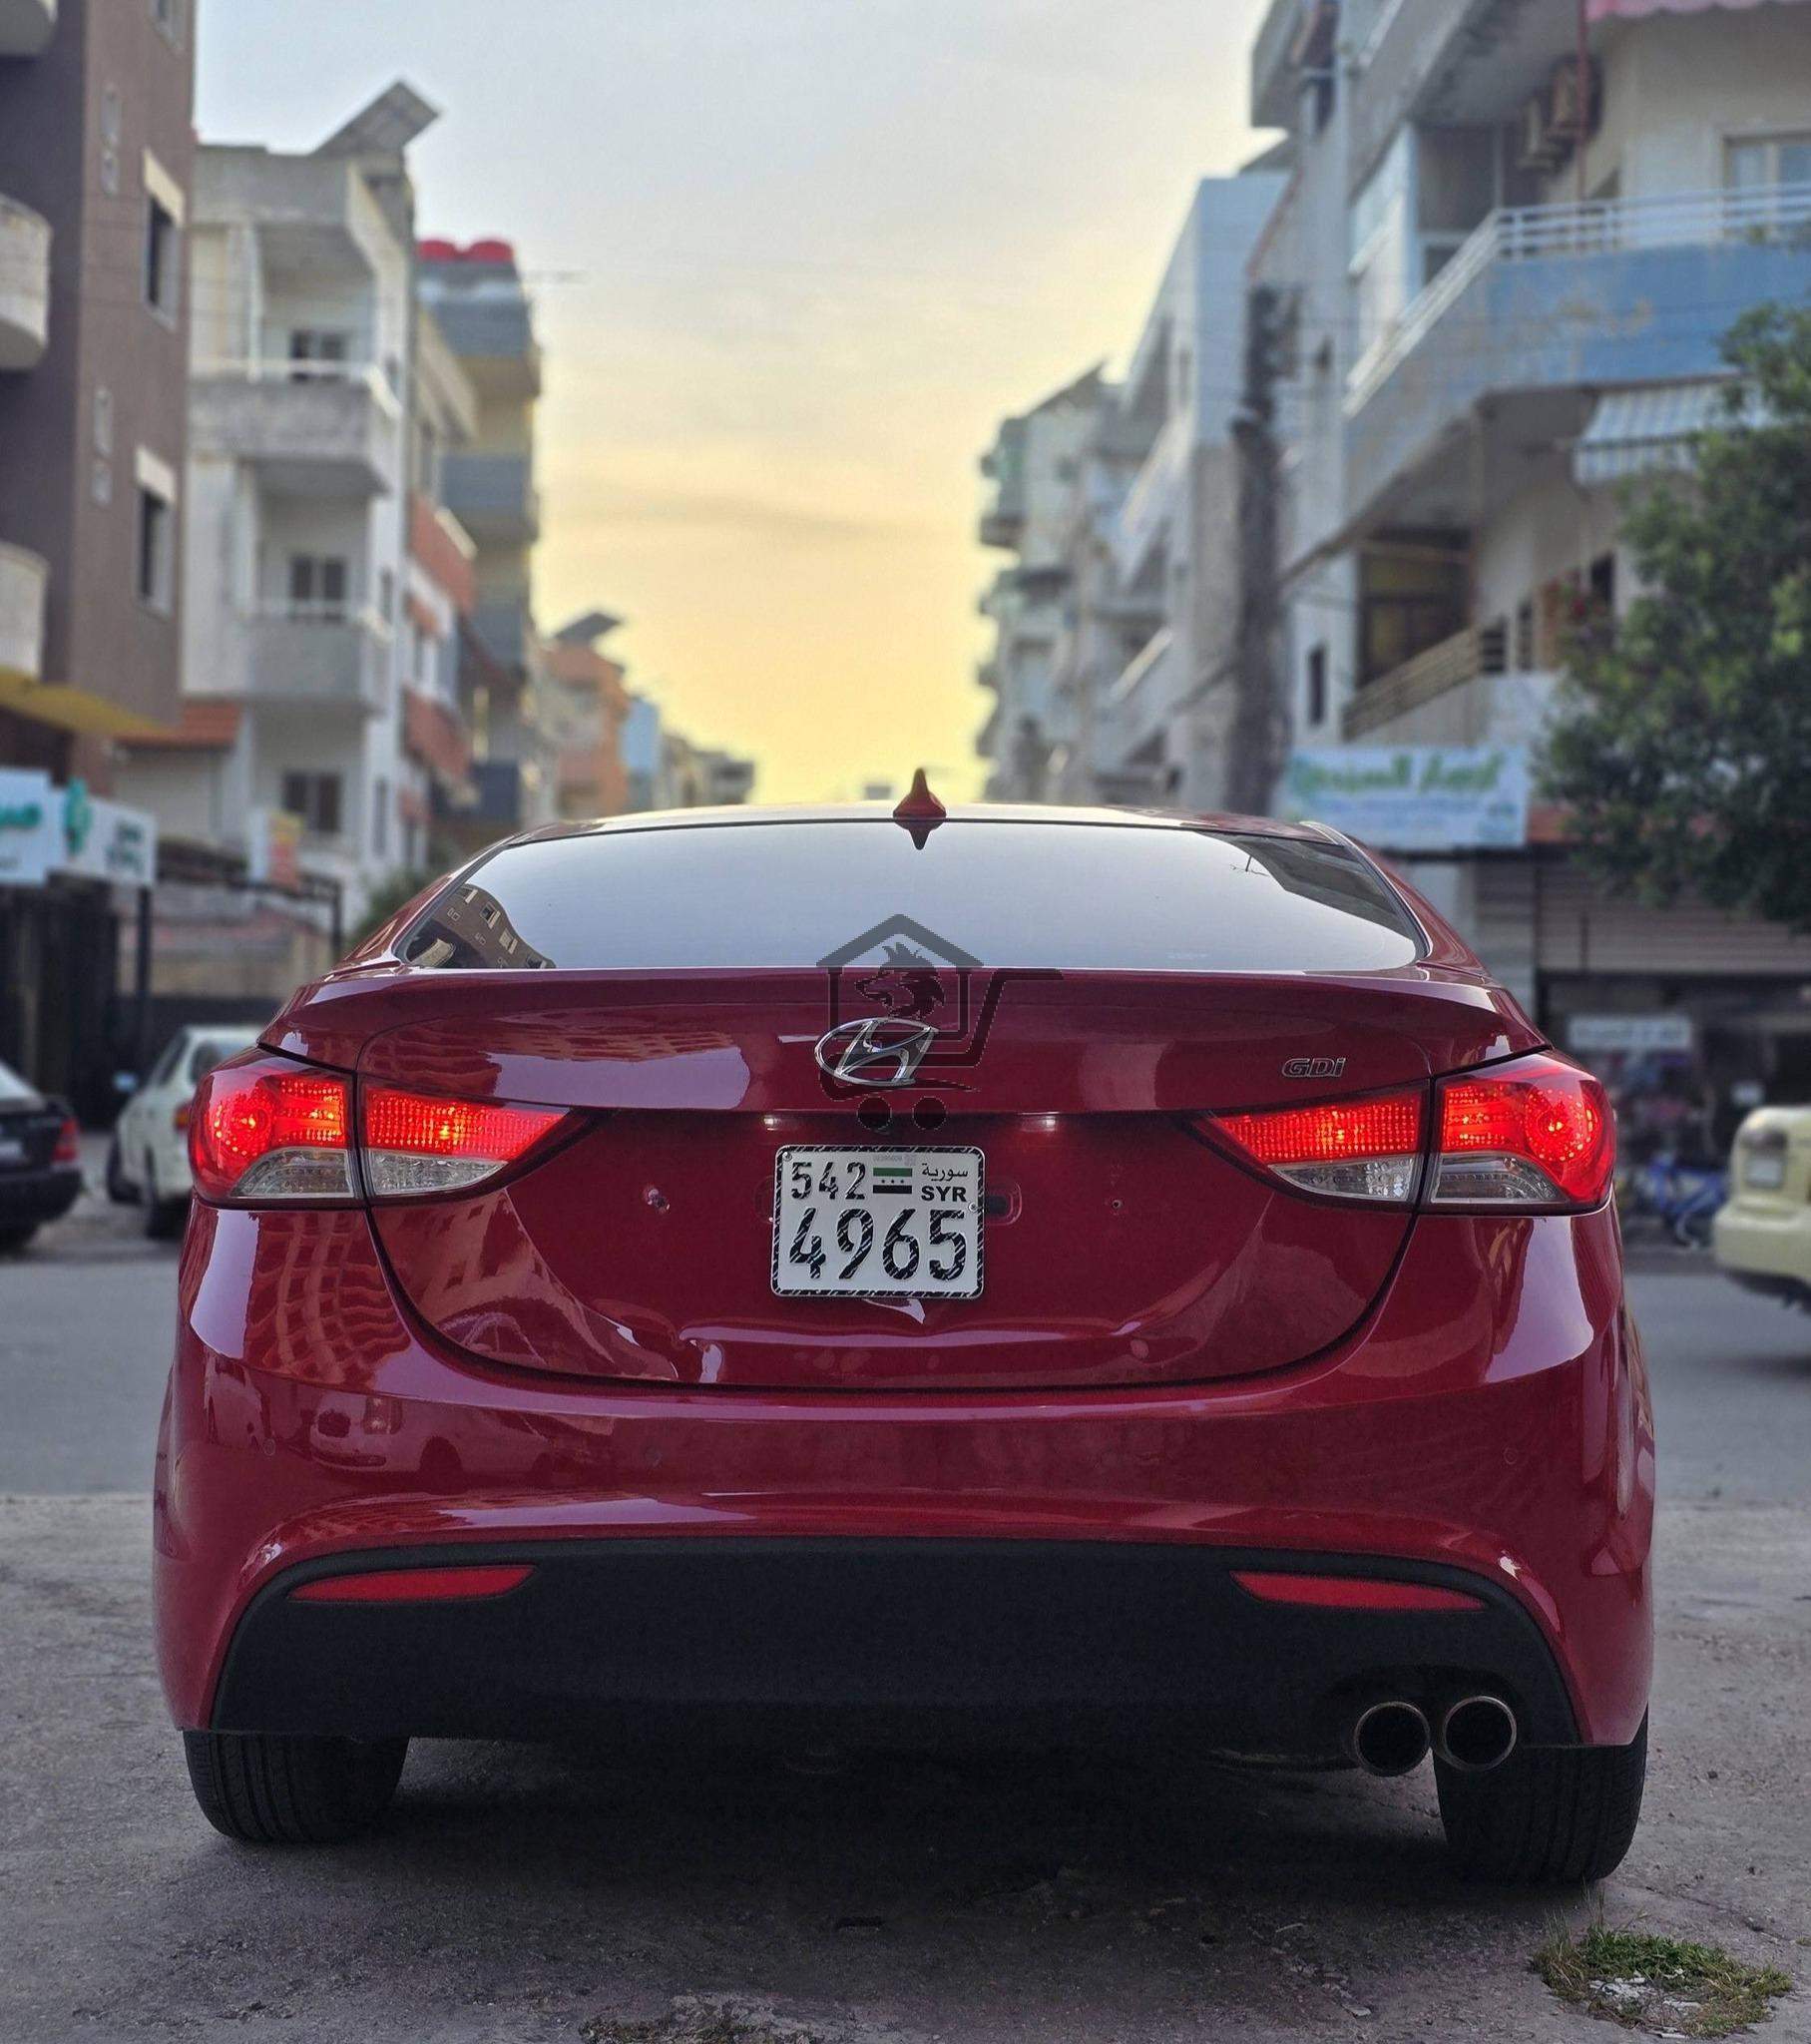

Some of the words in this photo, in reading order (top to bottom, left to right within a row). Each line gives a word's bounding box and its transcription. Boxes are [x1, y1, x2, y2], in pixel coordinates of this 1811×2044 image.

[1281, 1057, 1346, 1078] GDi
[791, 1162, 866, 1200] 542
[921, 1162, 969, 1182] سورية
[921, 1186, 967, 1203] SYR
[789, 1207, 967, 1280] 4965
